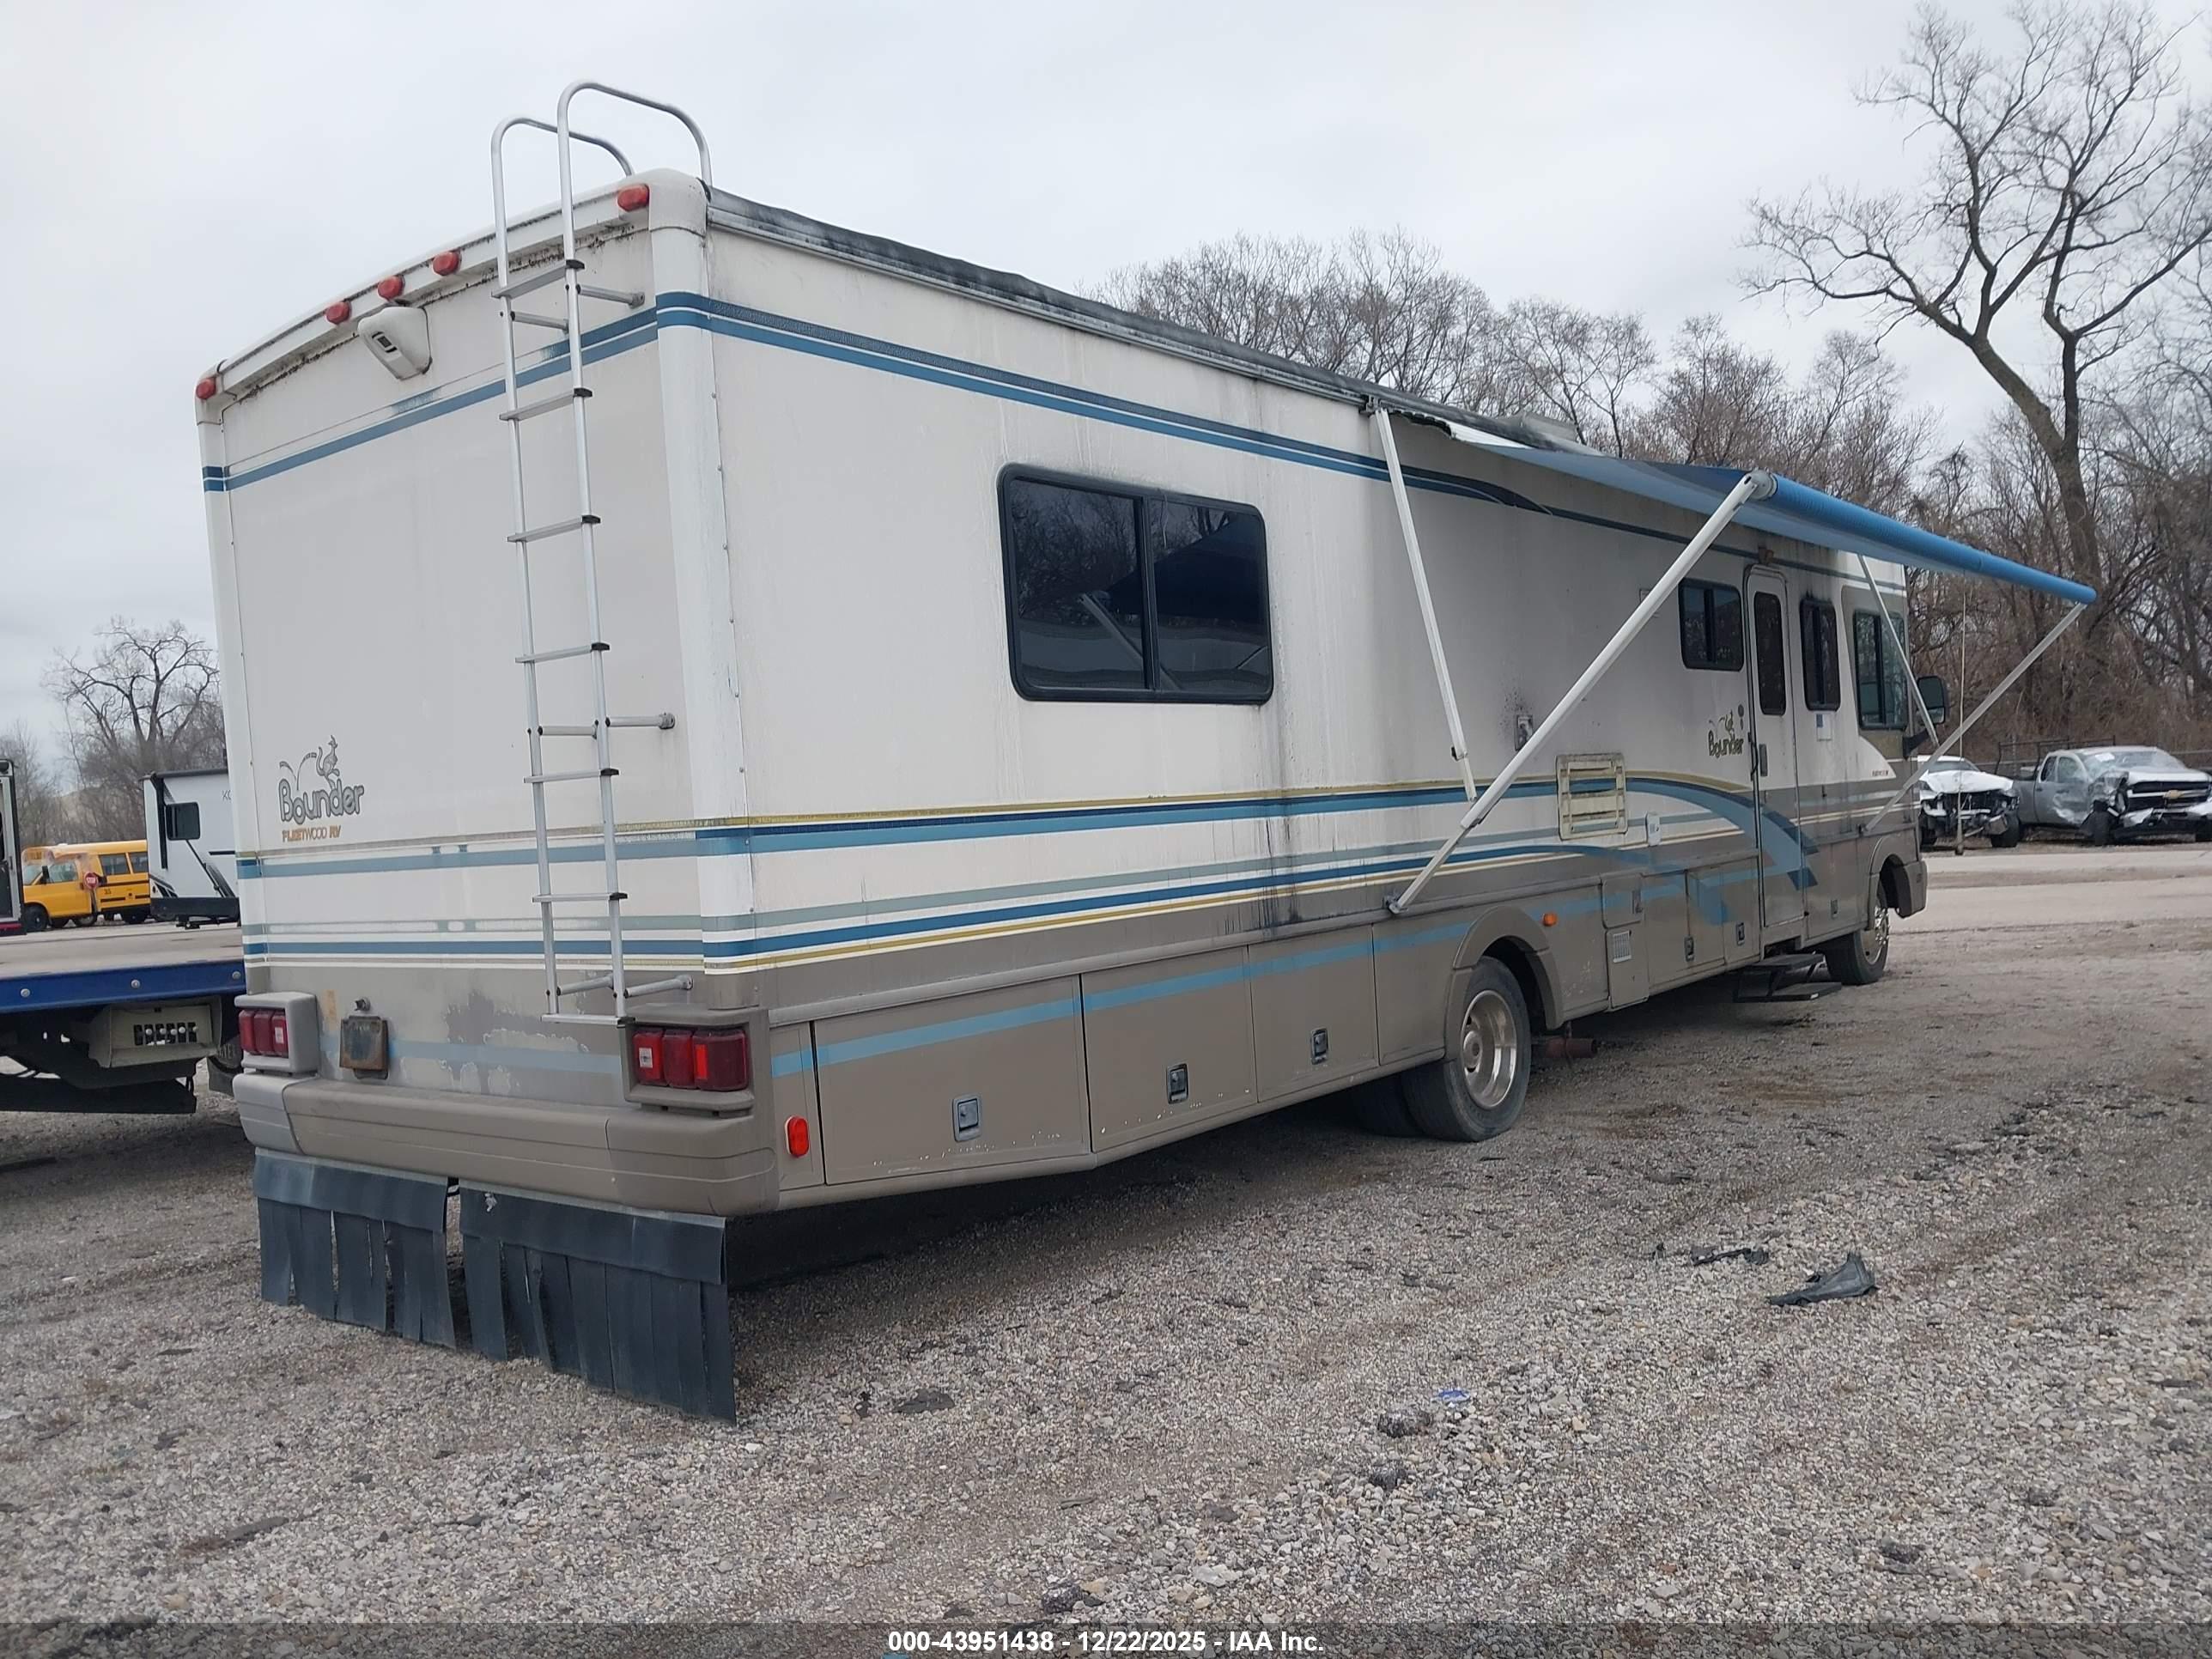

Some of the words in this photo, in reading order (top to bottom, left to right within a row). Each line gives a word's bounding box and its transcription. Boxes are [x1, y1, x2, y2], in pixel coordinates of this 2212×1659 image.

[1708, 730, 1744, 758] Bounder
[278, 778, 364, 825] Bounder
[282, 827, 327, 842] FLEETWOOD
[329, 825, 342, 839] RV
